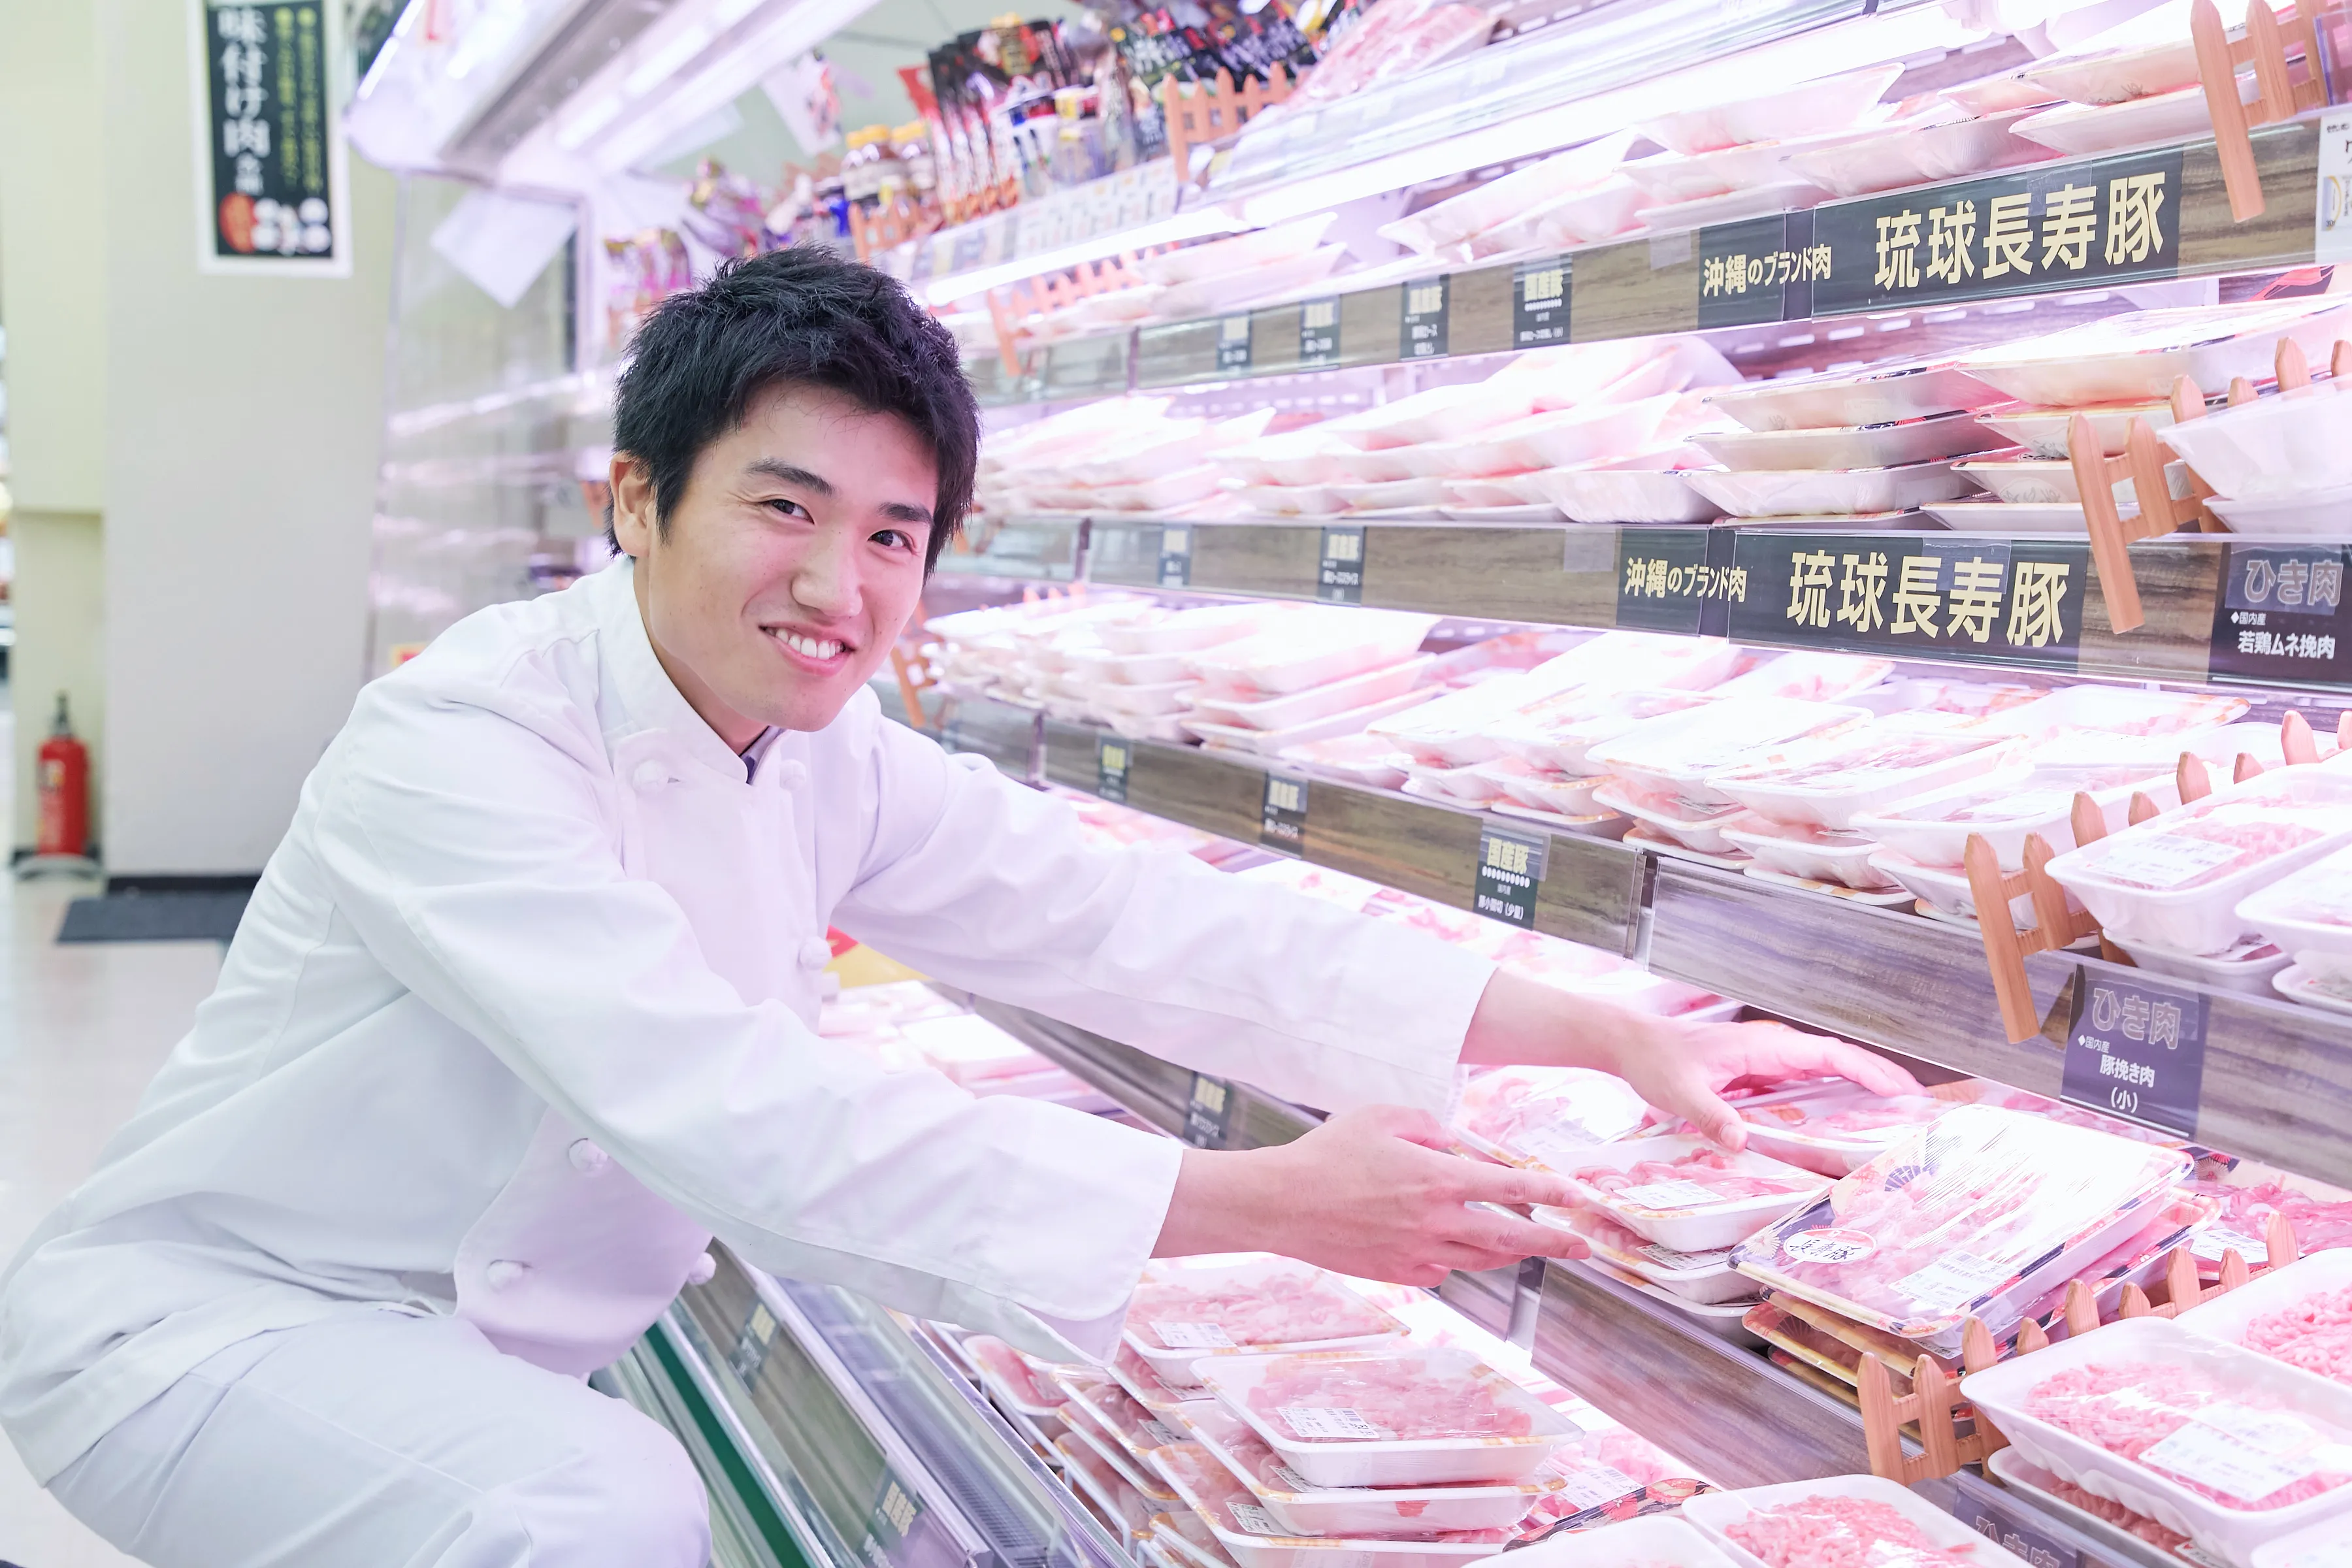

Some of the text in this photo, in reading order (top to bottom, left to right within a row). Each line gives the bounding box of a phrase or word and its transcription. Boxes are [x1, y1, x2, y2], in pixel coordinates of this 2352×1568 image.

[1703, 171, 2165, 297] 沖縄のブランド肉 琉球長寿豚
[1625, 550, 2070, 647] 沖縄のブランド肉 琉球長寿豚
[2244, 559, 2344, 606] ひき肉
[2238, 612, 2266, 626] 国内産
[2238, 630, 2336, 659] 若鶏ムネ挽肉
[2093, 988, 2181, 1050] ひき肉
[2085, 1036, 2110, 1053] 国内産
[2100, 1054, 2155, 1088] 豚挽き肉
[2111, 1087, 2138, 1113] (小)
